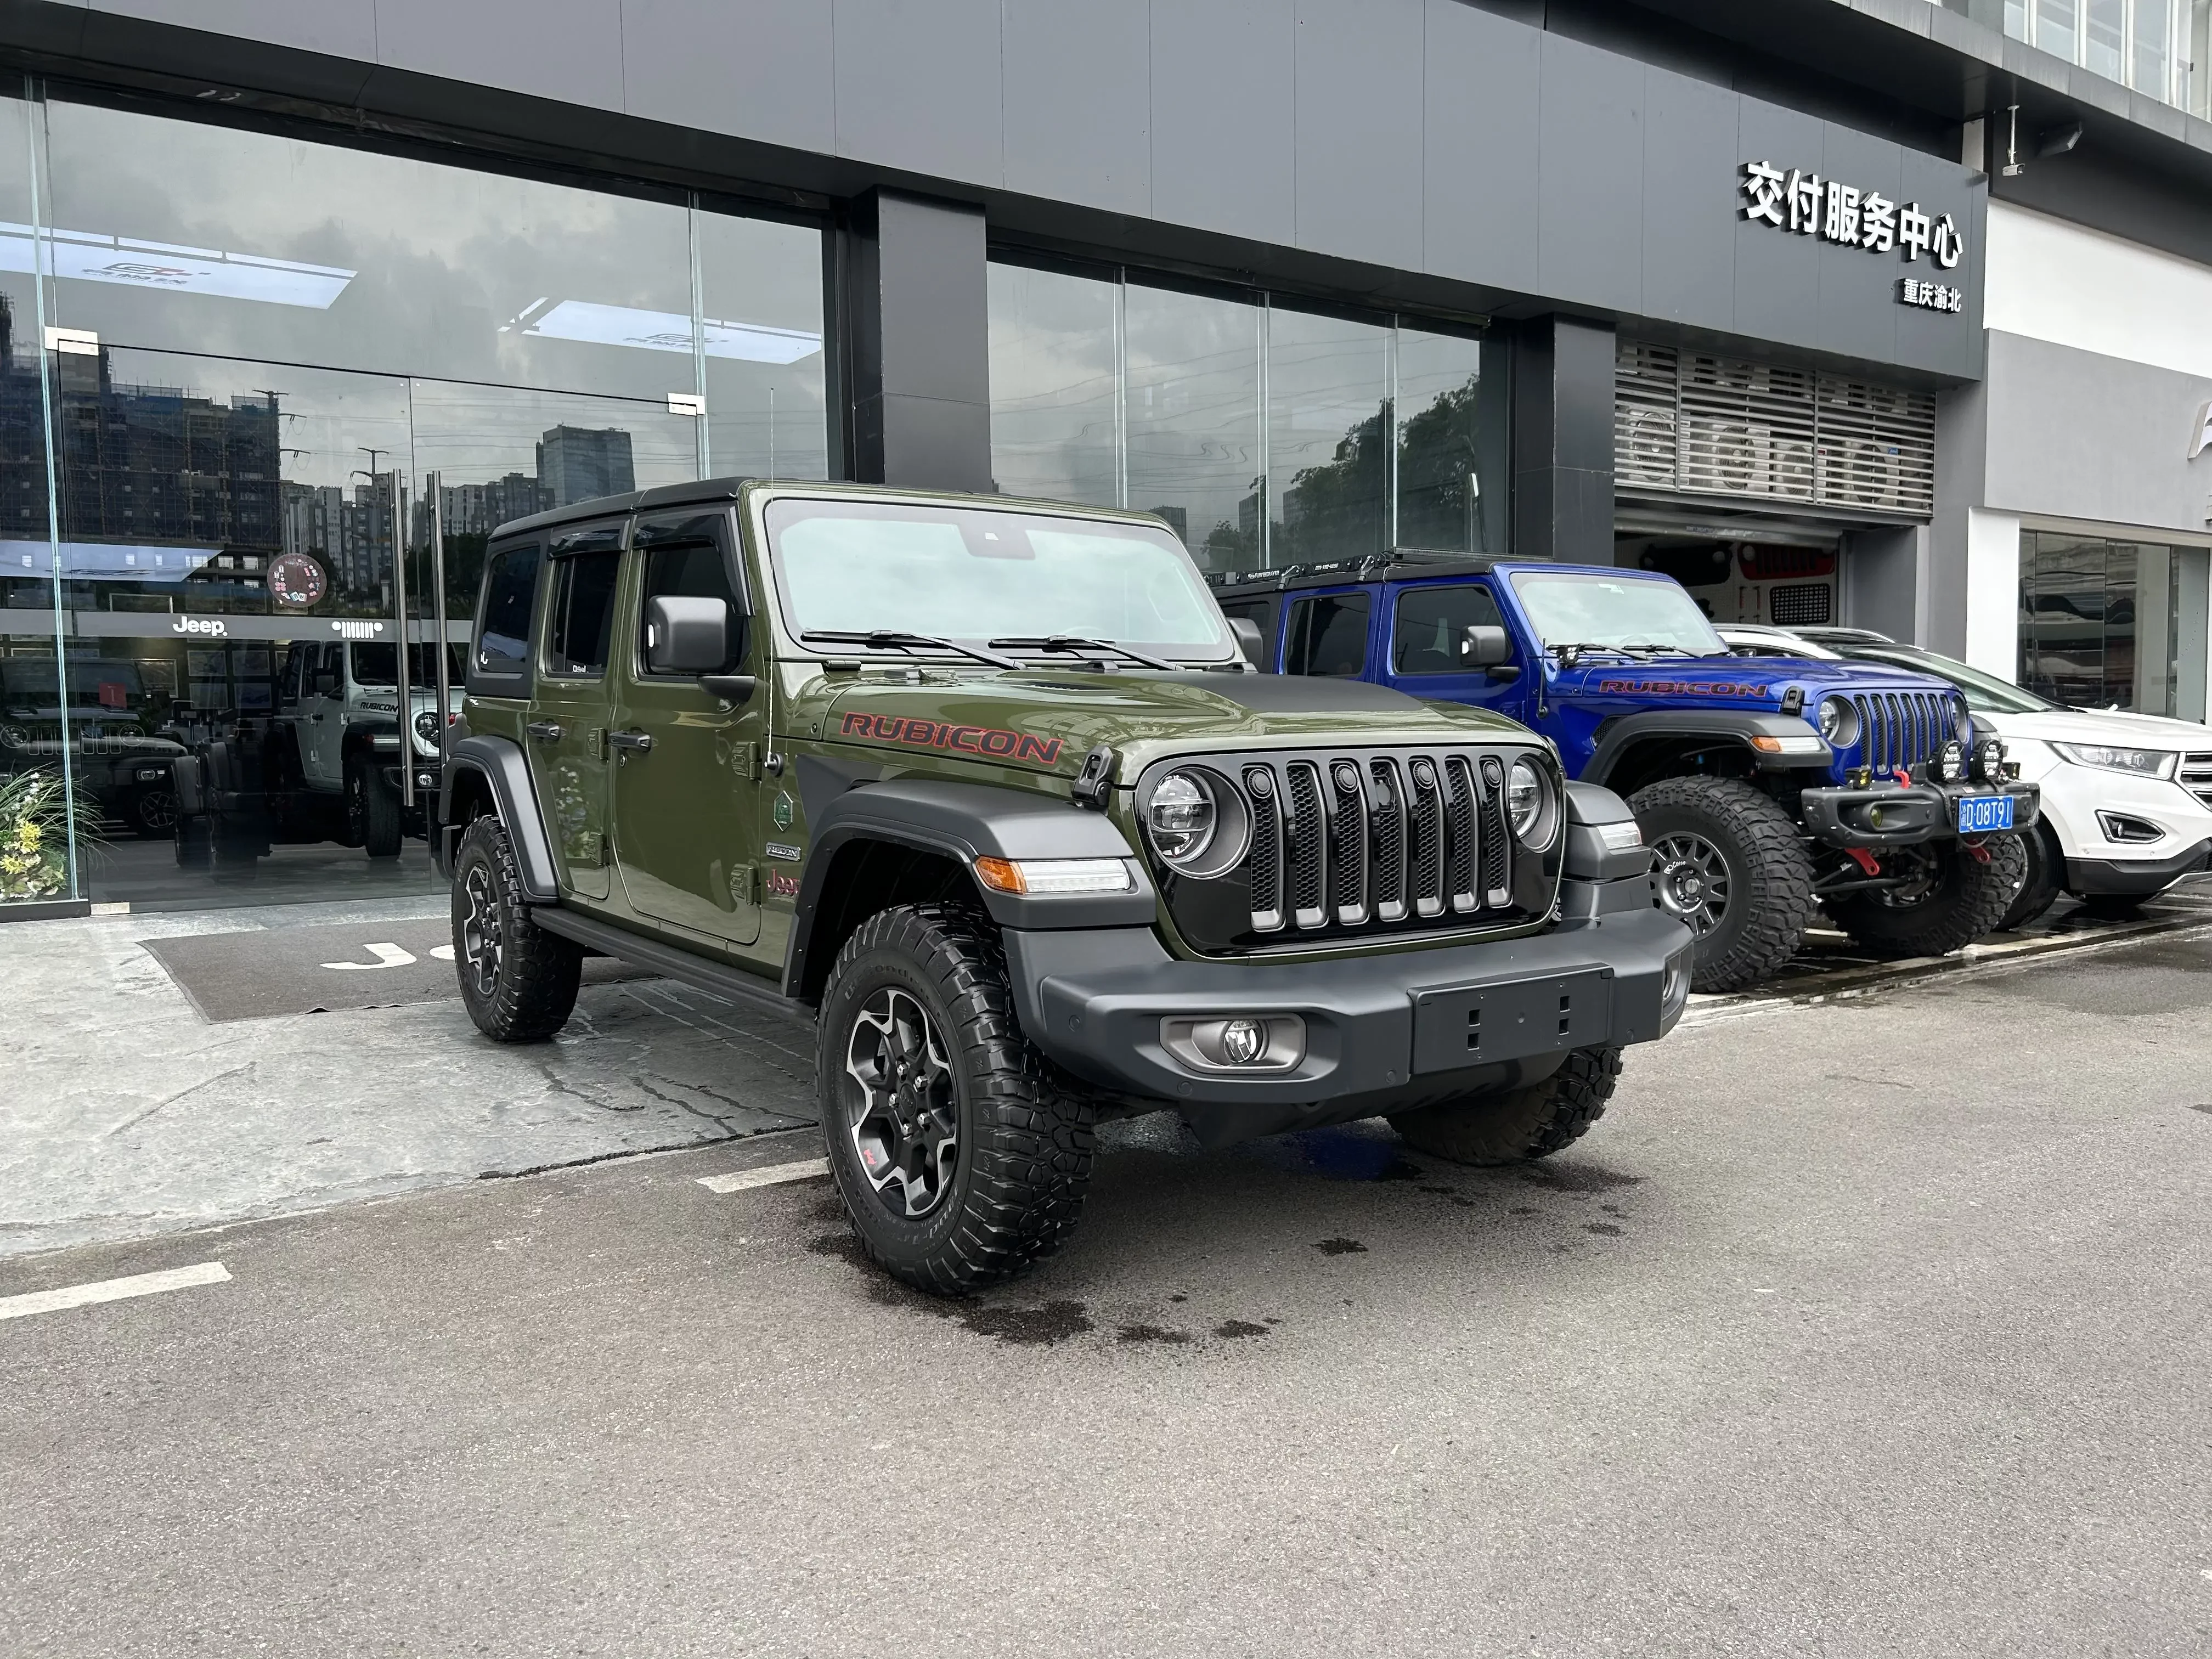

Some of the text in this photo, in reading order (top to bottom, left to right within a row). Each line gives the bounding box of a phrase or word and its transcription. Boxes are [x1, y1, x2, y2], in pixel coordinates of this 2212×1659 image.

[1743, 161, 1963, 268] 交付服务中心
[1901, 278, 1962, 313] 重庆渝北
[1598, 680, 1769, 697] RUBICON
[360, 702, 399, 712] RUBICON
[840, 711, 1065, 764] RUBICON
